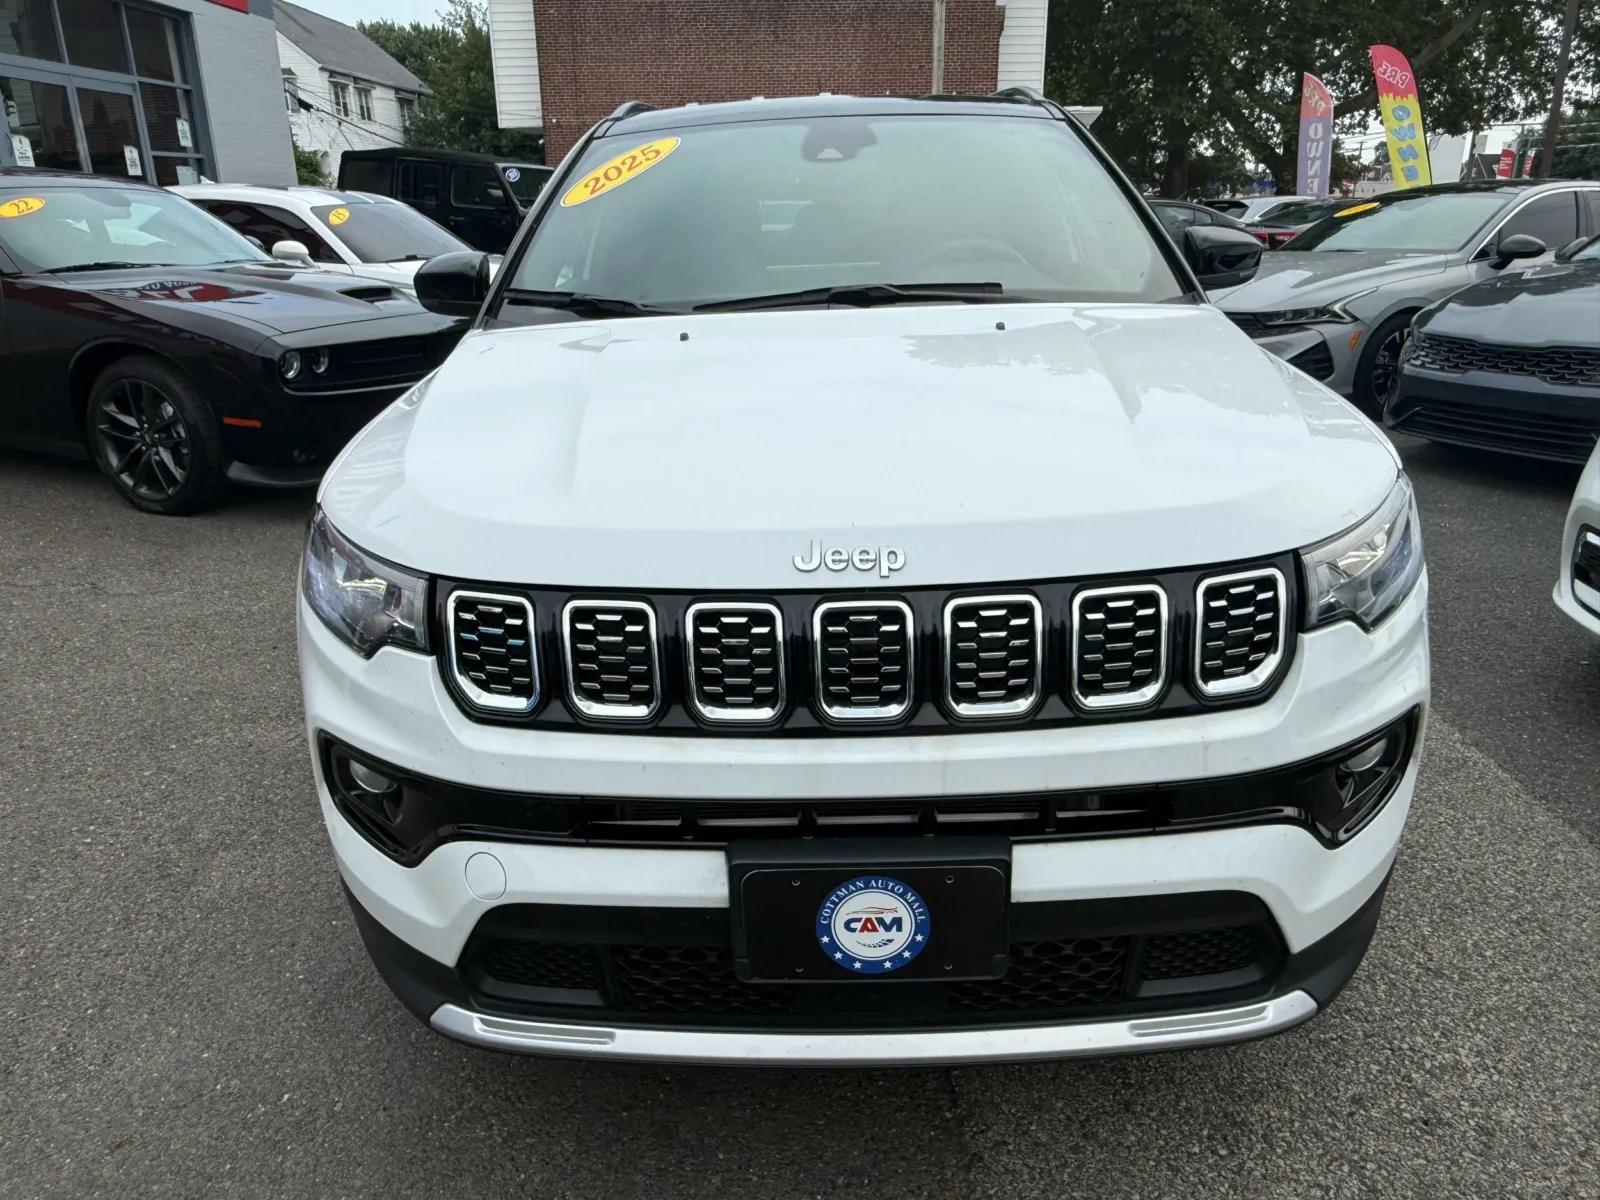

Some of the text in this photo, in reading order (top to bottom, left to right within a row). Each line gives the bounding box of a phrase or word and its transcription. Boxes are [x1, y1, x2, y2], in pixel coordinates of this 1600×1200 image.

[584, 145, 661, 195] 2025
[9, 200, 33, 215] 22
[792, 539, 906, 578] Jeep
[820, 880, 926, 924] COTTMAN AUTO MALL
[843, 917, 903, 933] CAM
